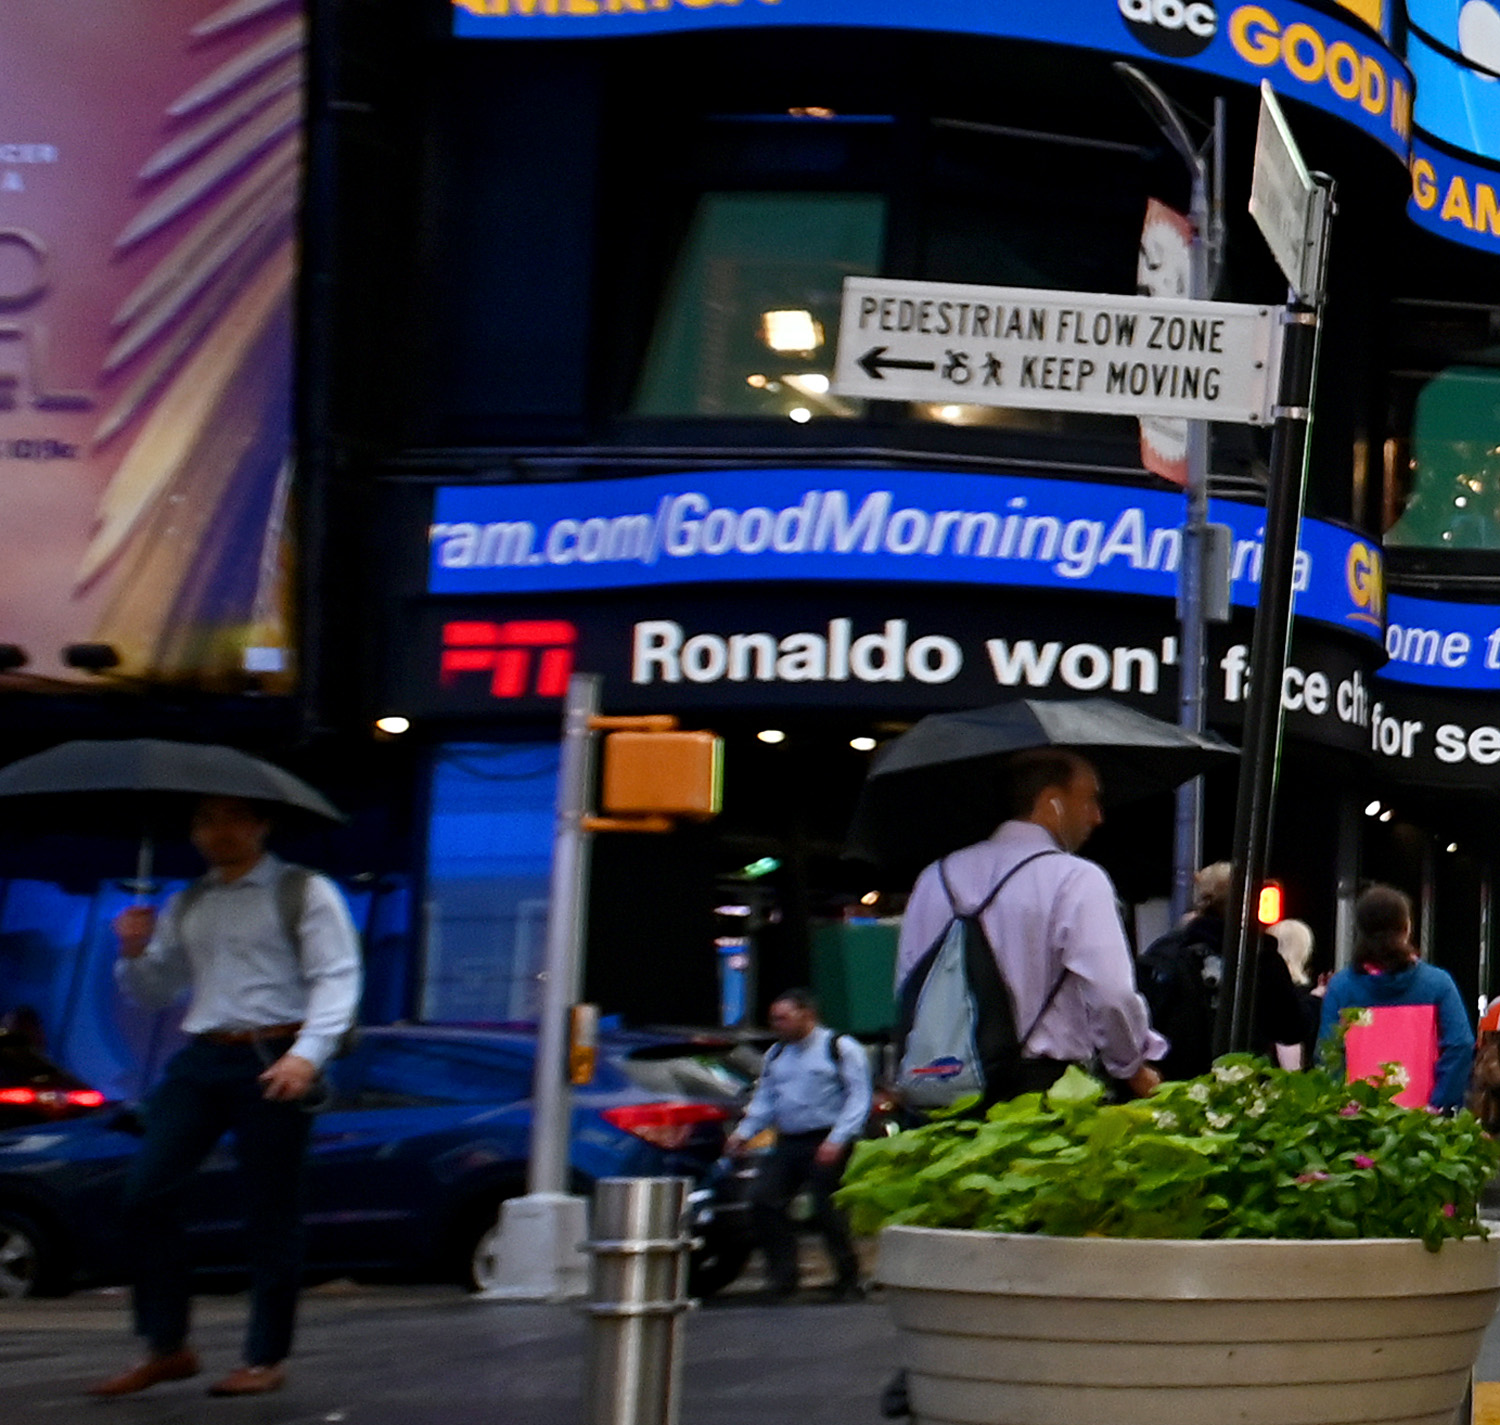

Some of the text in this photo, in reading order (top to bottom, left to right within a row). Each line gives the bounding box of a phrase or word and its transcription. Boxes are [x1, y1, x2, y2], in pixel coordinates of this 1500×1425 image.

[1229, 4, 1387, 114] GOOD
[859, 296, 1225, 354] PEDESTRIAN FLOW ZONE
[1019, 355, 1221, 402] KEEP MOVING
[632, 617, 963, 684] Ronaldo
[987, 636, 1207, 695] won'
[1220, 644, 1330, 716] fce
[1372, 703, 1424, 758] for
